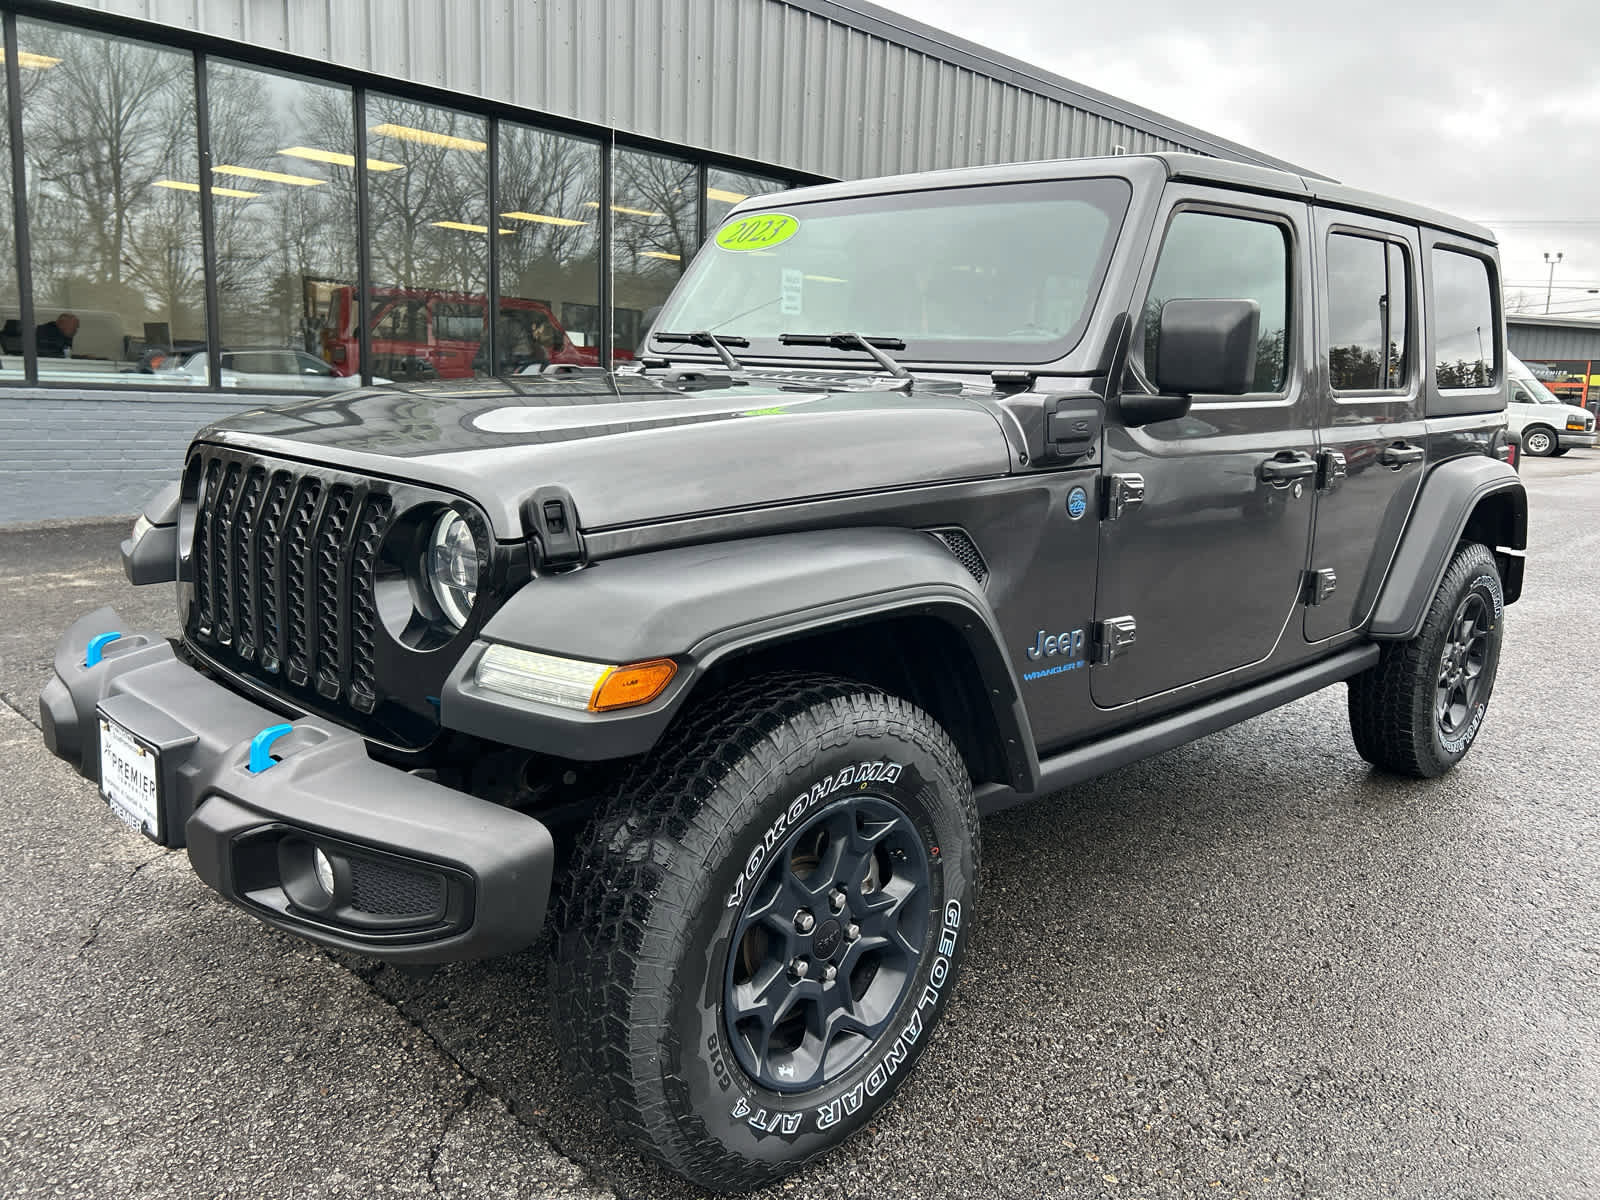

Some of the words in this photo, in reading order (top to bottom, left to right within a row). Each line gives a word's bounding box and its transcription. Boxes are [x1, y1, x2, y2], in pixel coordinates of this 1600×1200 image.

[723, 219, 787, 244] 2023
[1027, 629, 1085, 661] Jeep
[1023, 662, 1076, 681] WRANGLER
[112, 752, 157, 801] PREMIER
[110, 798, 142, 834] PREMIER
[728, 761, 903, 908] YOKOHAMA
[816, 899, 961, 1130] GEOLANDAR
